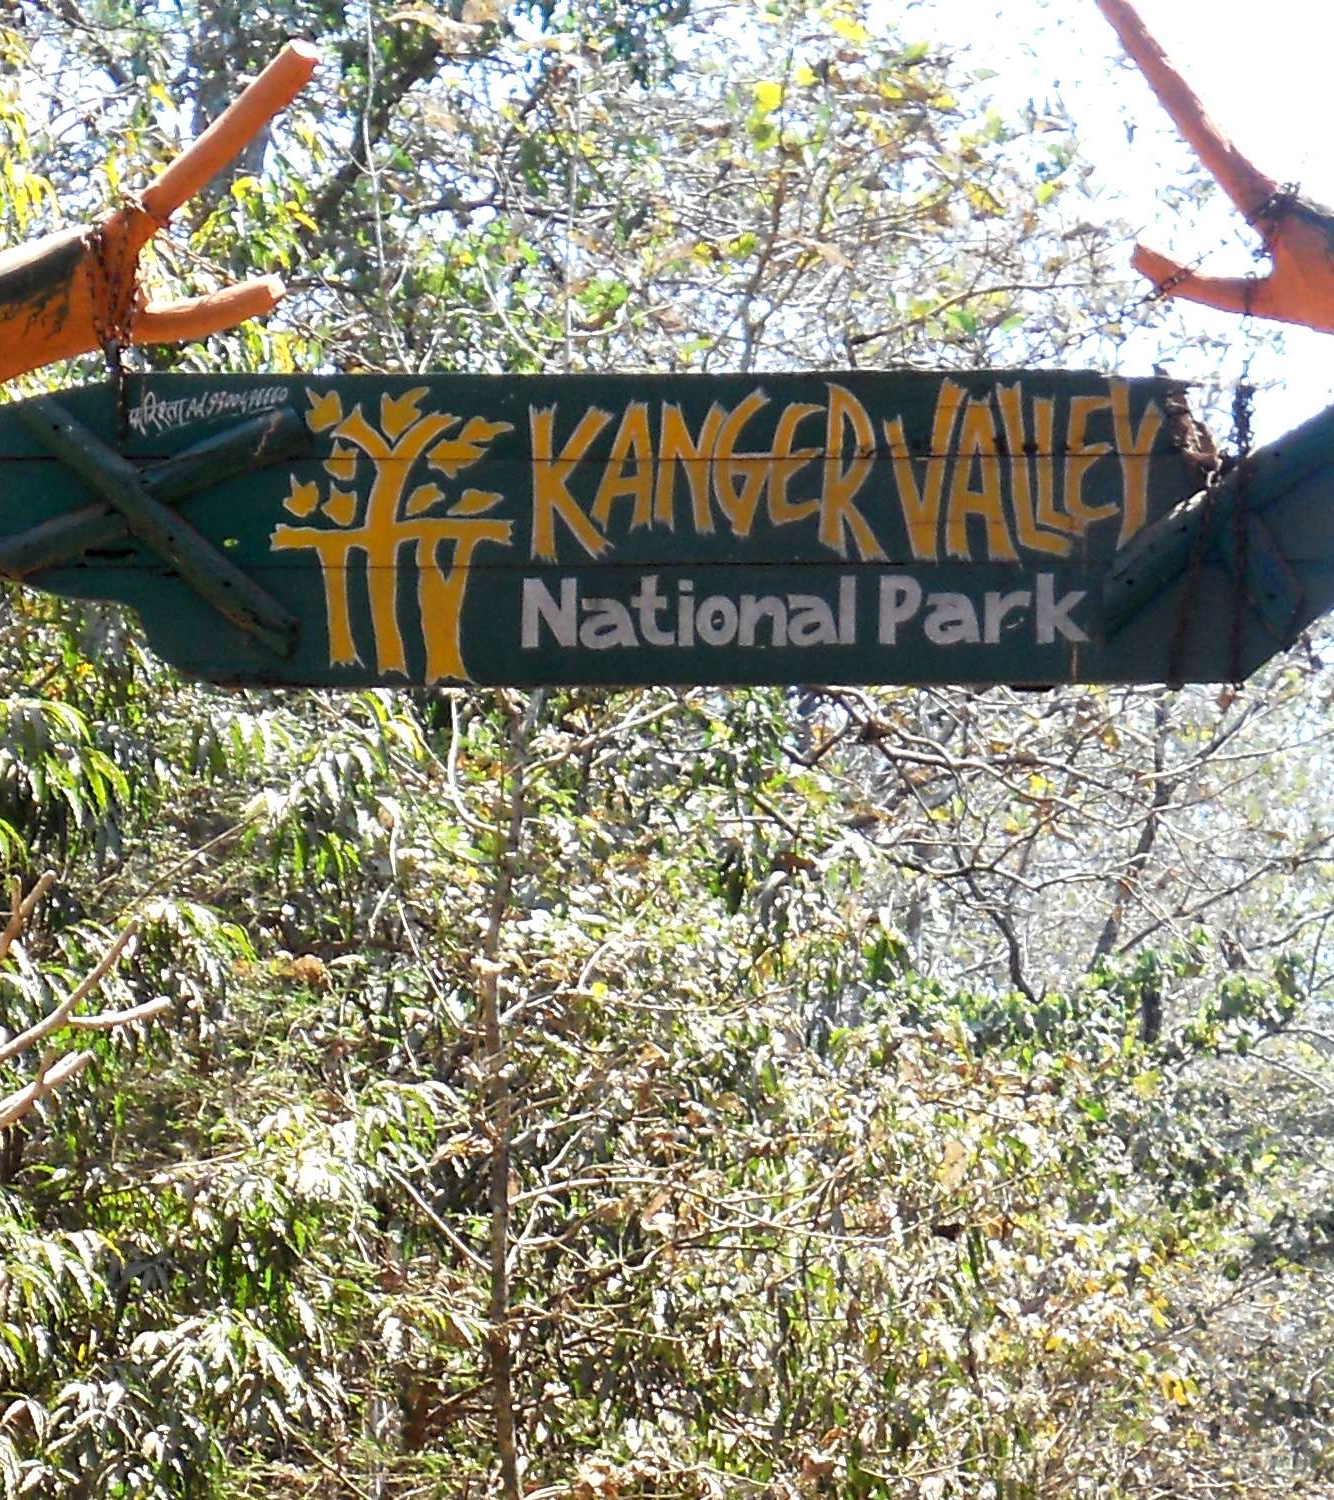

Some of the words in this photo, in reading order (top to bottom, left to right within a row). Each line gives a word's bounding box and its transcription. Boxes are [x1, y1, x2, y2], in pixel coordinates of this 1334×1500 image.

[528, 381, 890, 566] KANGER
[882, 376, 1163, 568] VALLEY
[521, 575, 857, 650] National
[878, 572, 1092, 646] Park
